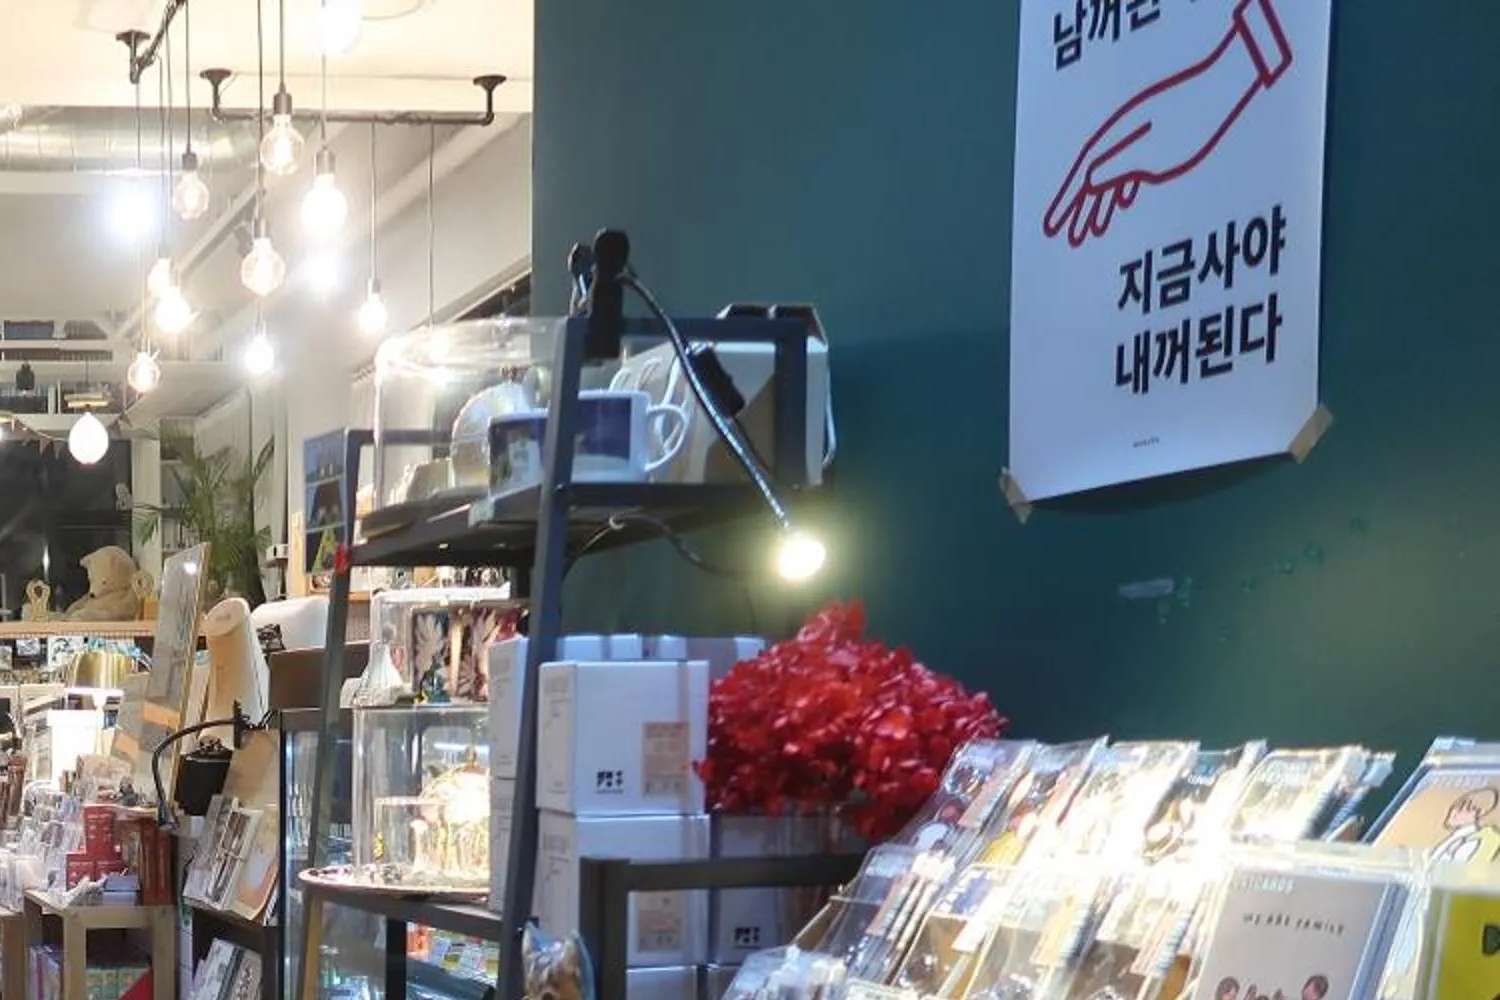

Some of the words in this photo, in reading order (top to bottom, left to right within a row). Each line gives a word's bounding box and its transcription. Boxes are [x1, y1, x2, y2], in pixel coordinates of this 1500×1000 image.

[1053, 0, 1197, 71] 남꺼
[1117, 203, 1288, 315] 지금사야
[1114, 293, 1283, 395] 내꺼된다
